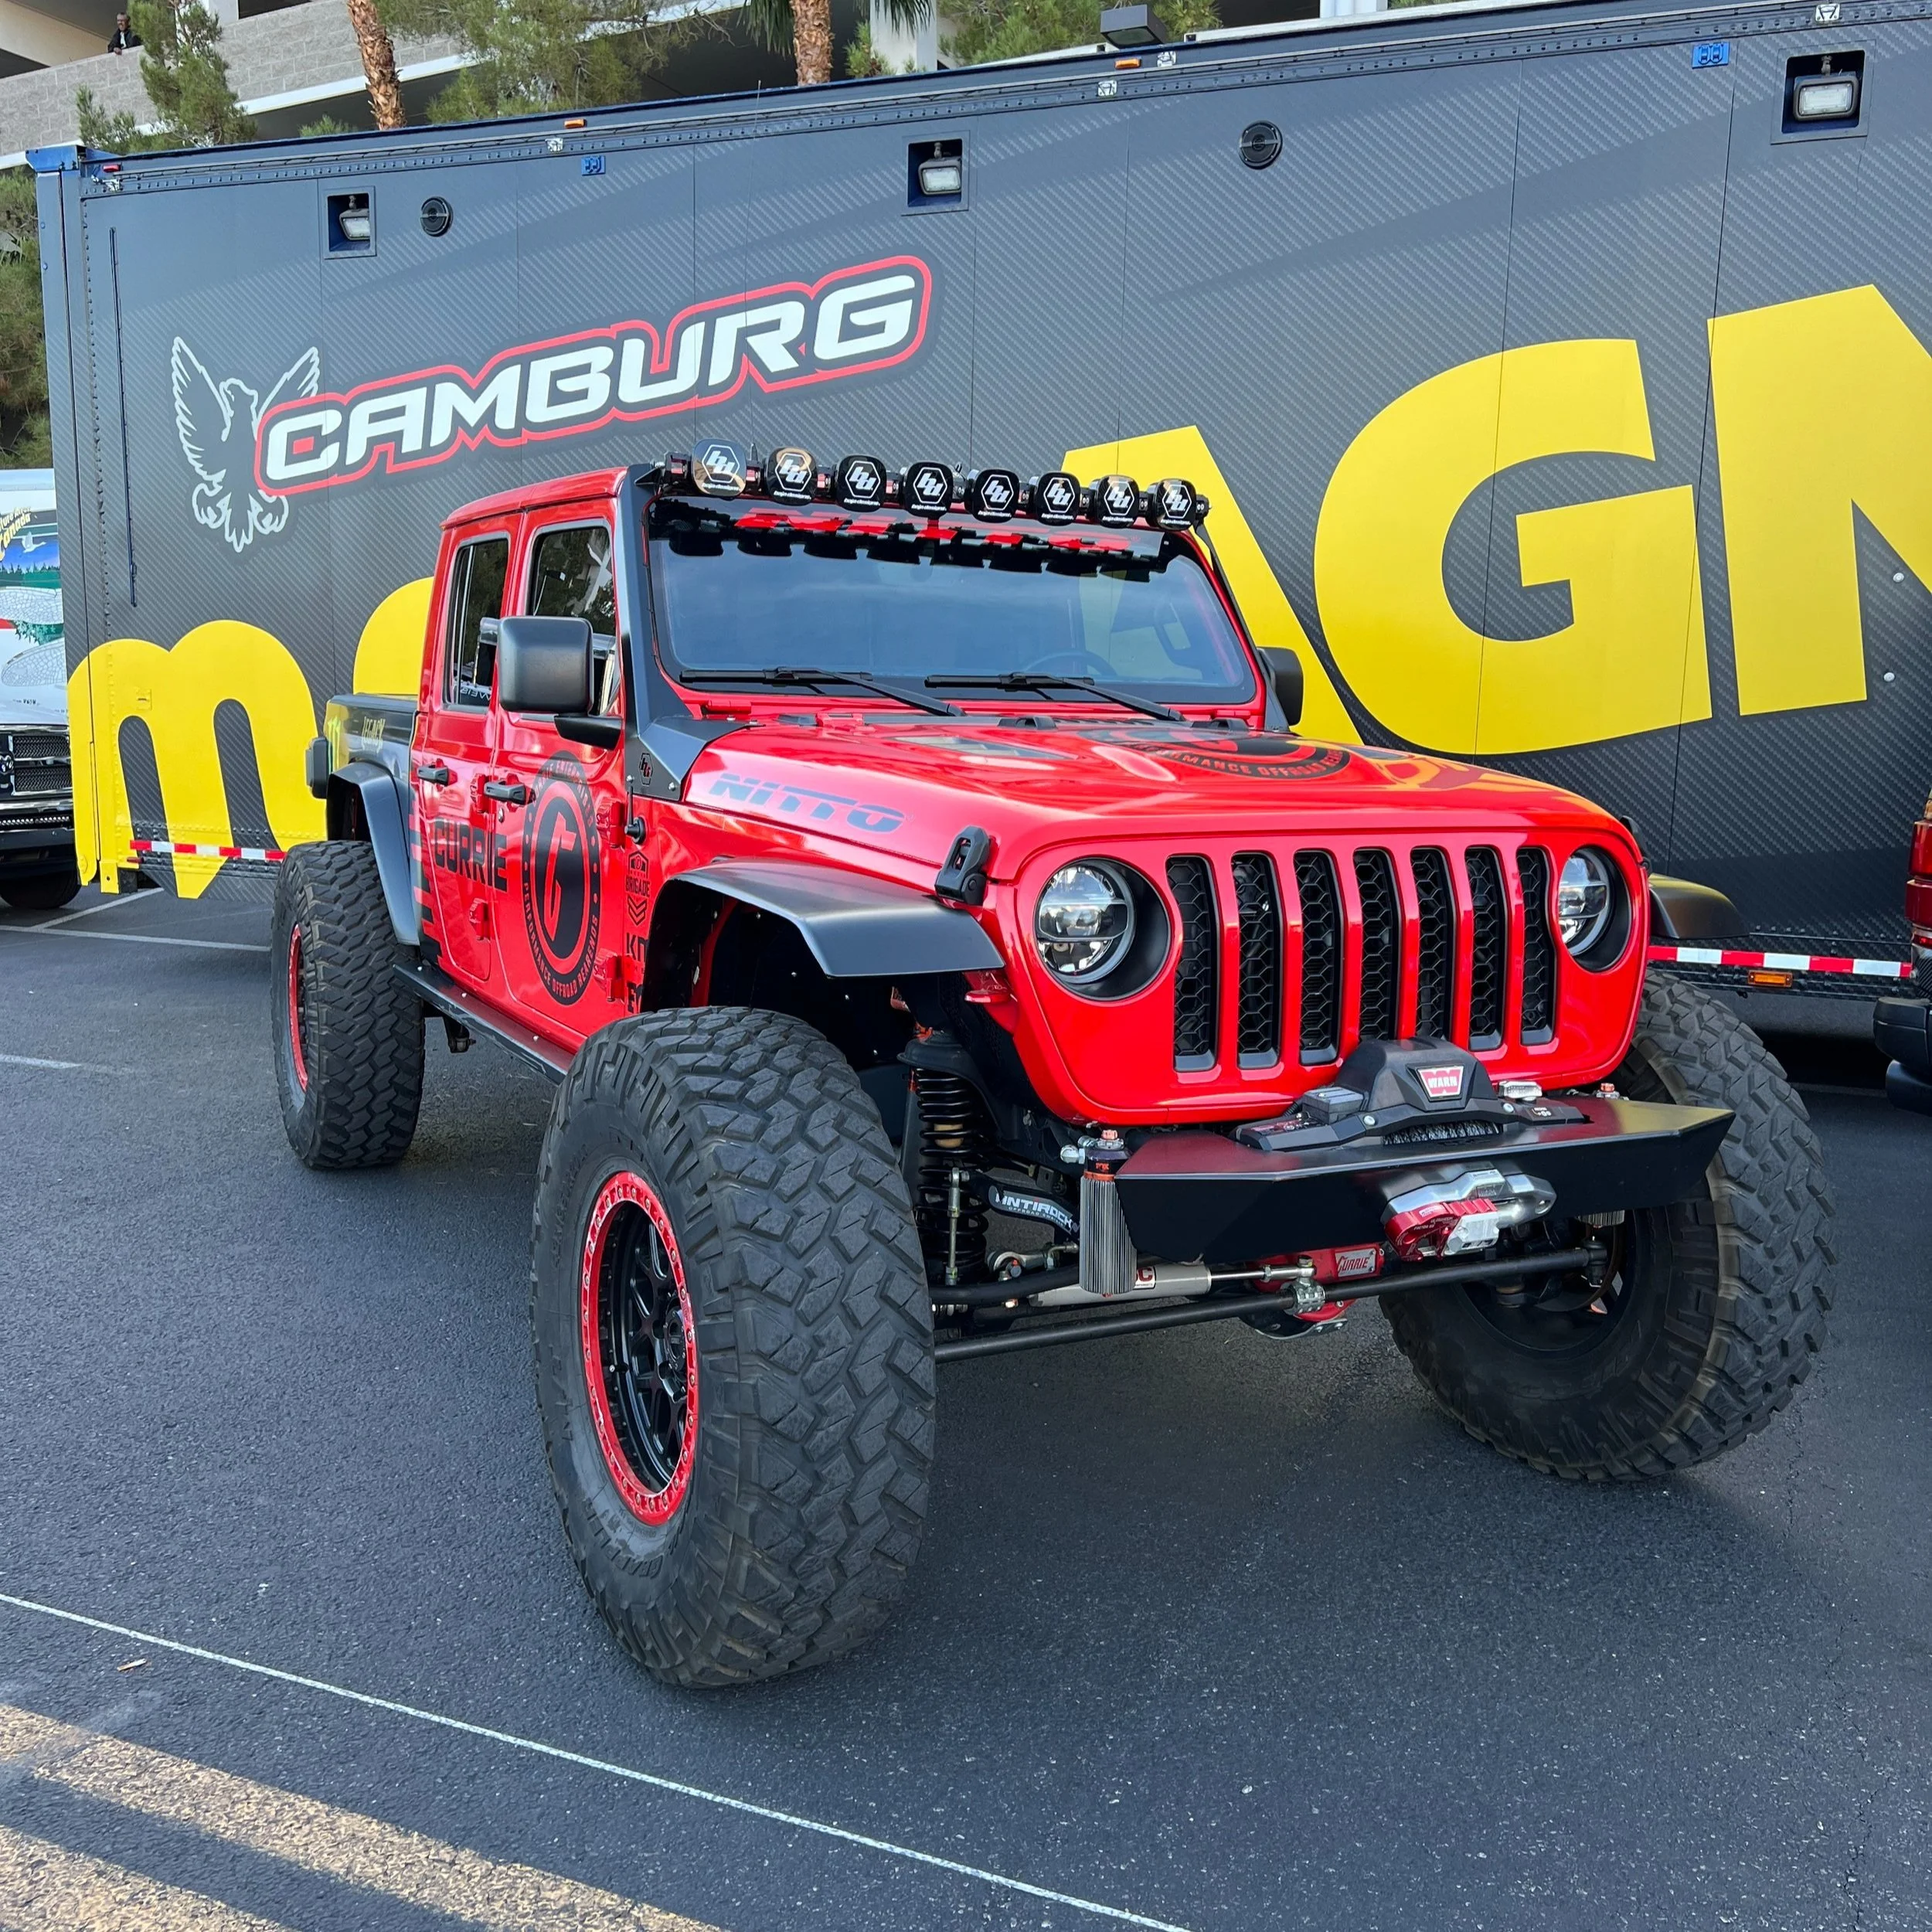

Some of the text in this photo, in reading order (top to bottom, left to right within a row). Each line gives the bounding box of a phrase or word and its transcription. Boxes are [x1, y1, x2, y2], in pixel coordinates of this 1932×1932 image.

[265, 274, 916, 481] CAMBURG
[709, 773, 905, 832] NITTO
[434, 818, 508, 893] CURRIE
[625, 874, 650, 898] BRIGADE
[524, 883, 598, 998] PERFORMANCE OFFROAD REARENDS
[1428, 1076, 1458, 1089] WARN
[1338, 1256, 1370, 1272] CURRIE
